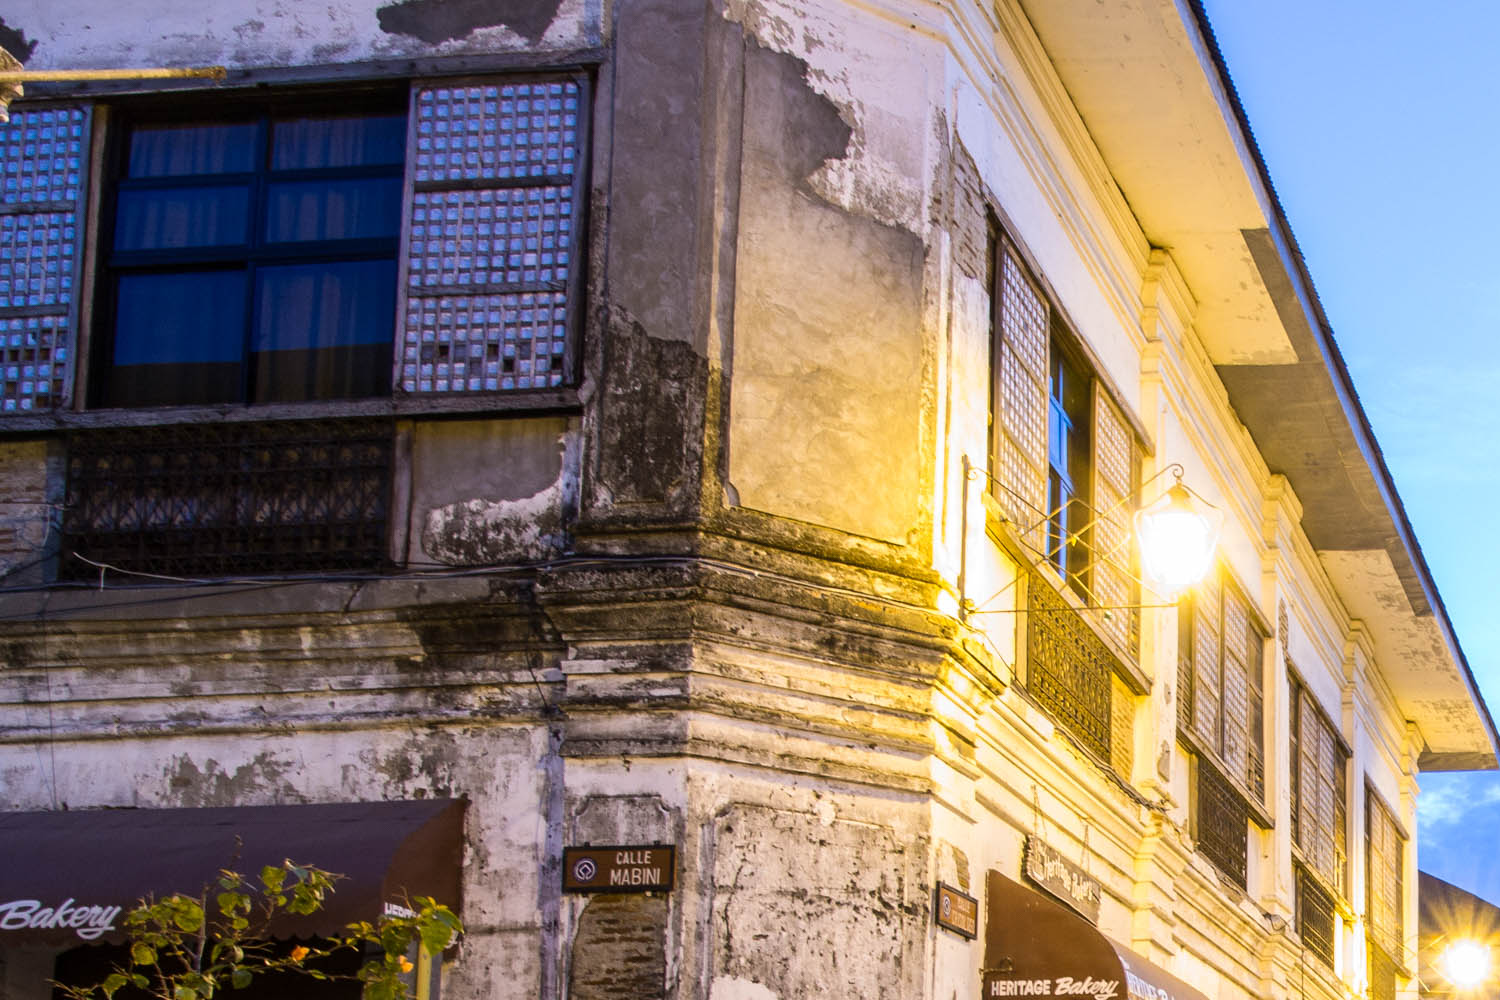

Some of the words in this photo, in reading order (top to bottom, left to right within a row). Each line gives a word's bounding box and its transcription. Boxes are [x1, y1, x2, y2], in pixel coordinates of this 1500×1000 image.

[616, 850, 652, 865] CALLE
[610, 867, 661, 886] MABINI
[0, 898, 122, 939] Bakery
[991, 980, 1051, 997] HERITAGE
[1054, 976, 1120, 1000] Bakery
